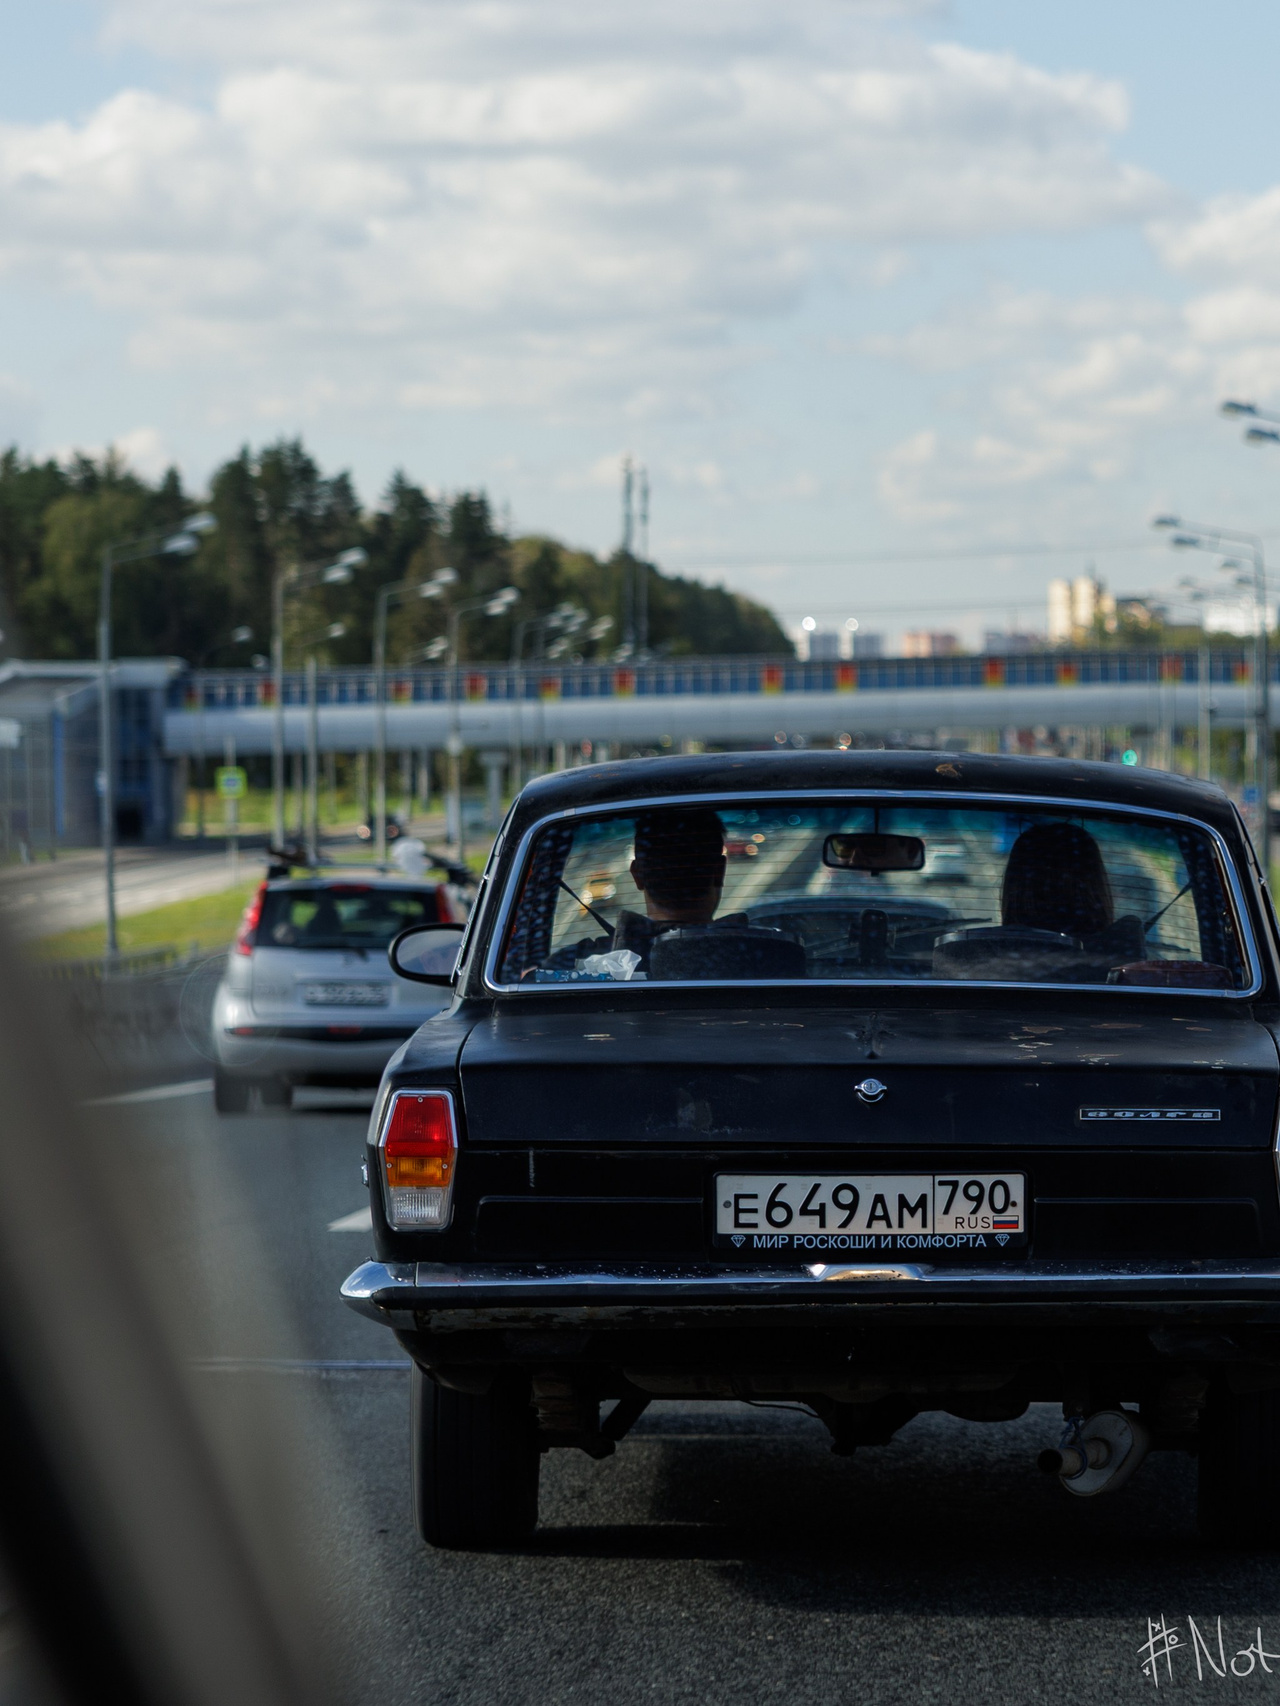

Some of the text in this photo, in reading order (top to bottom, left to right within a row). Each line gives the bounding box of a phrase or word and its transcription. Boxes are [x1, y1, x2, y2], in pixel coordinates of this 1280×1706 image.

[937, 1179, 1011, 1215] 790
[954, 1216, 991, 1230] RUS
[753, 1235, 987, 1249] МИР РОСКОШИ И КОМФОРТА
